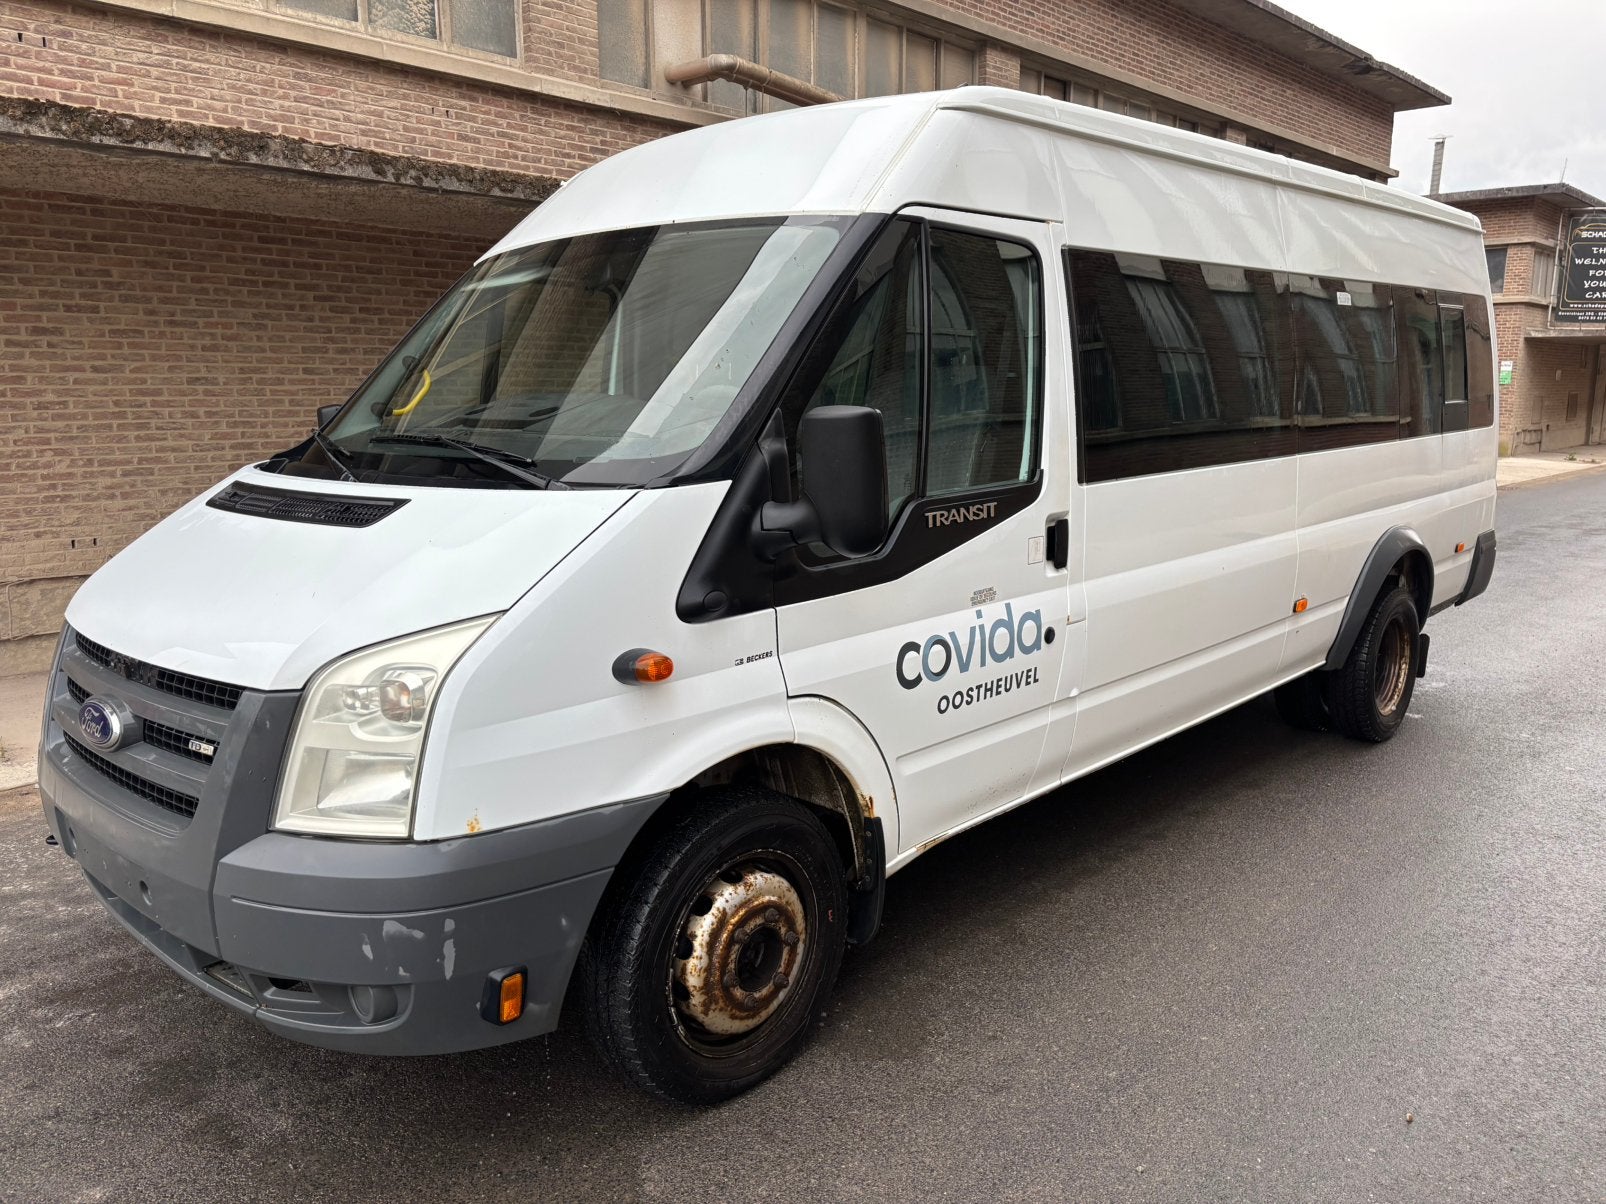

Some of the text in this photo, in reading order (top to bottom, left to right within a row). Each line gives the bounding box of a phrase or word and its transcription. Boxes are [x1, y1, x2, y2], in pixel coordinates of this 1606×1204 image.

[924, 502, 998, 528] TRANSIT
[746, 650, 773, 663] BECKERS
[896, 602, 1042, 690] covida
[937, 667, 1040, 715] OOSTHEUVEL
[81, 706, 103, 738] Ford
